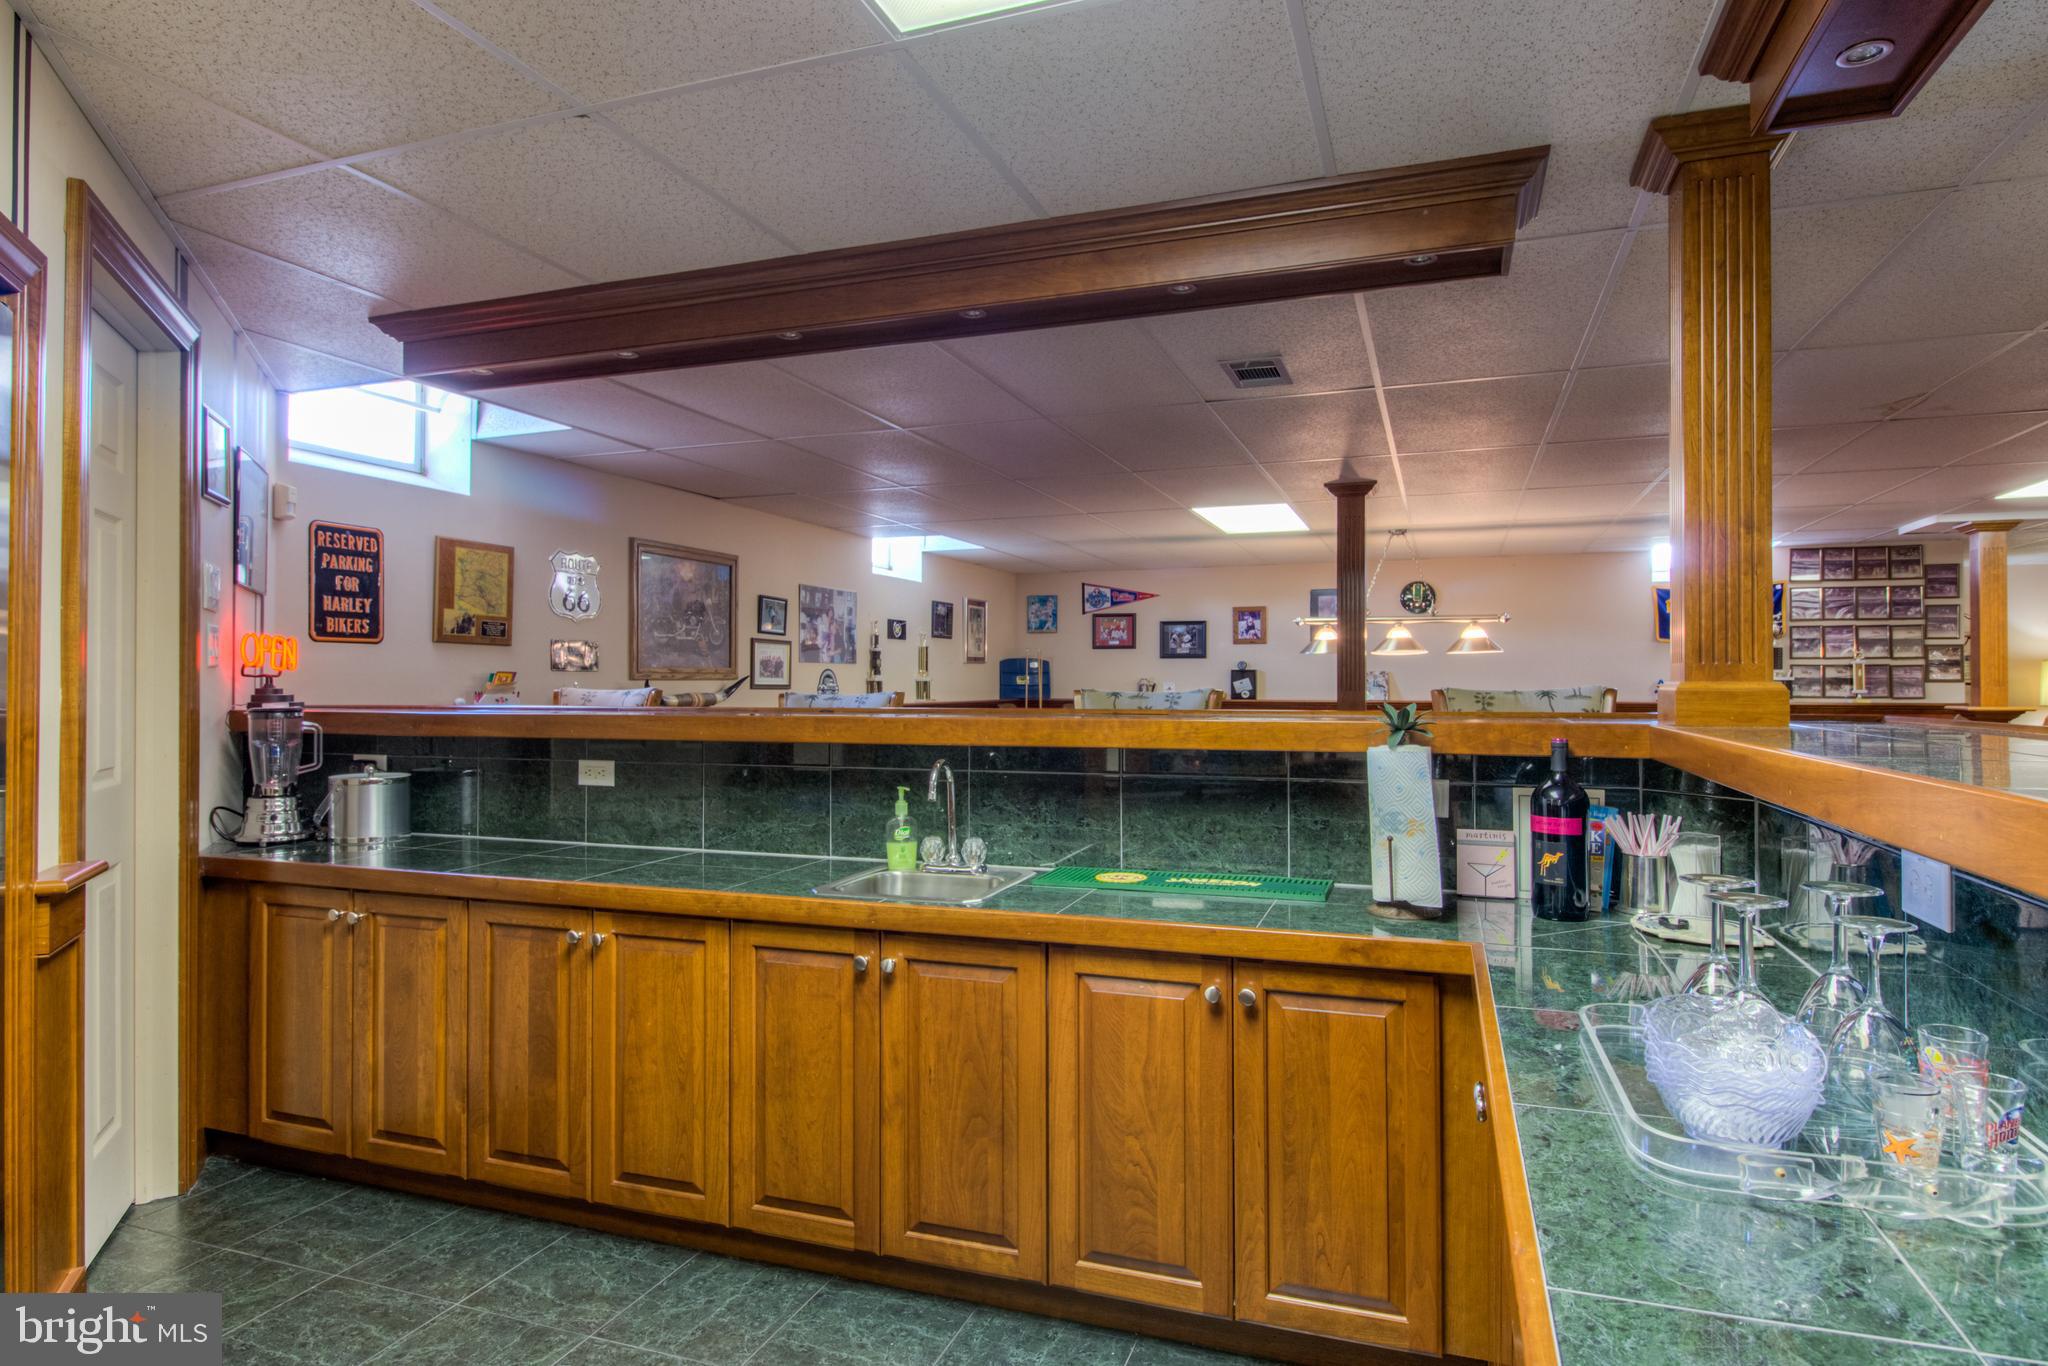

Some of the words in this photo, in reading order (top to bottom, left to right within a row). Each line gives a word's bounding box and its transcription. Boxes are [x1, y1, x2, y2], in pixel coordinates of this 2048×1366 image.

[317, 530, 378, 553] RESERVED
[321, 553, 374, 573] PARKING
[560, 557, 592, 571] ROUTE
[335, 575, 360, 592] FOR
[323, 595, 373, 614] HARLEY
[563, 588, 591, 613] 66
[326, 617, 371, 634] BIKERS
[240, 632, 298, 671] OPEN
[1466, 831, 1507, 840] martinis
